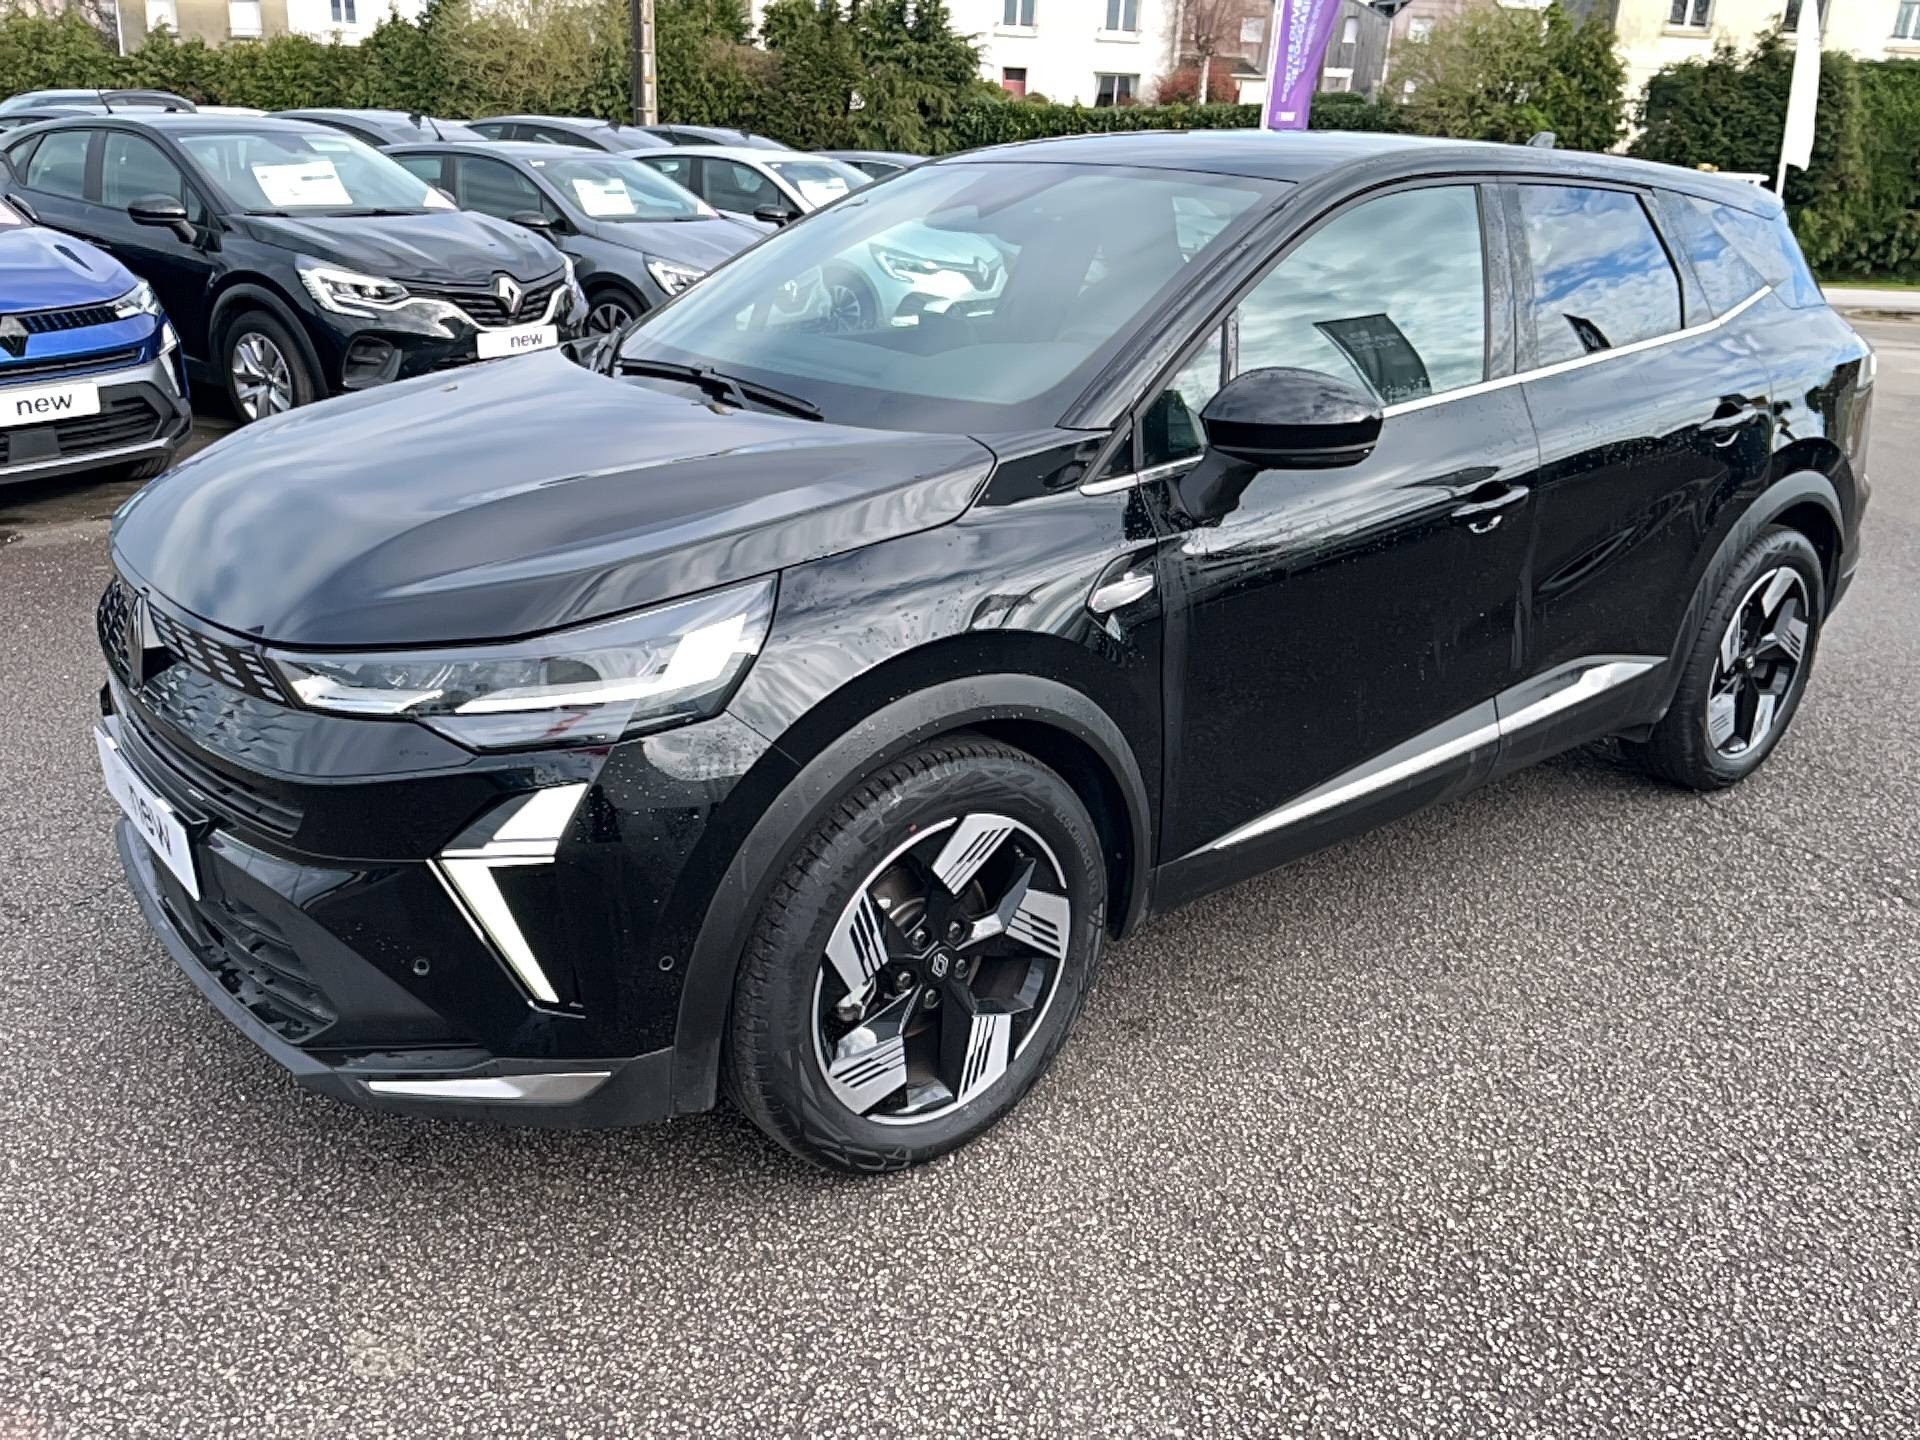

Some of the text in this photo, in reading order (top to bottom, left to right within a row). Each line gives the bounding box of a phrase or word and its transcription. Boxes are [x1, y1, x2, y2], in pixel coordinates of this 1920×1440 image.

[510, 333, 543, 348] new
[16, 393, 72, 416] new
[128, 783, 172, 857] new
